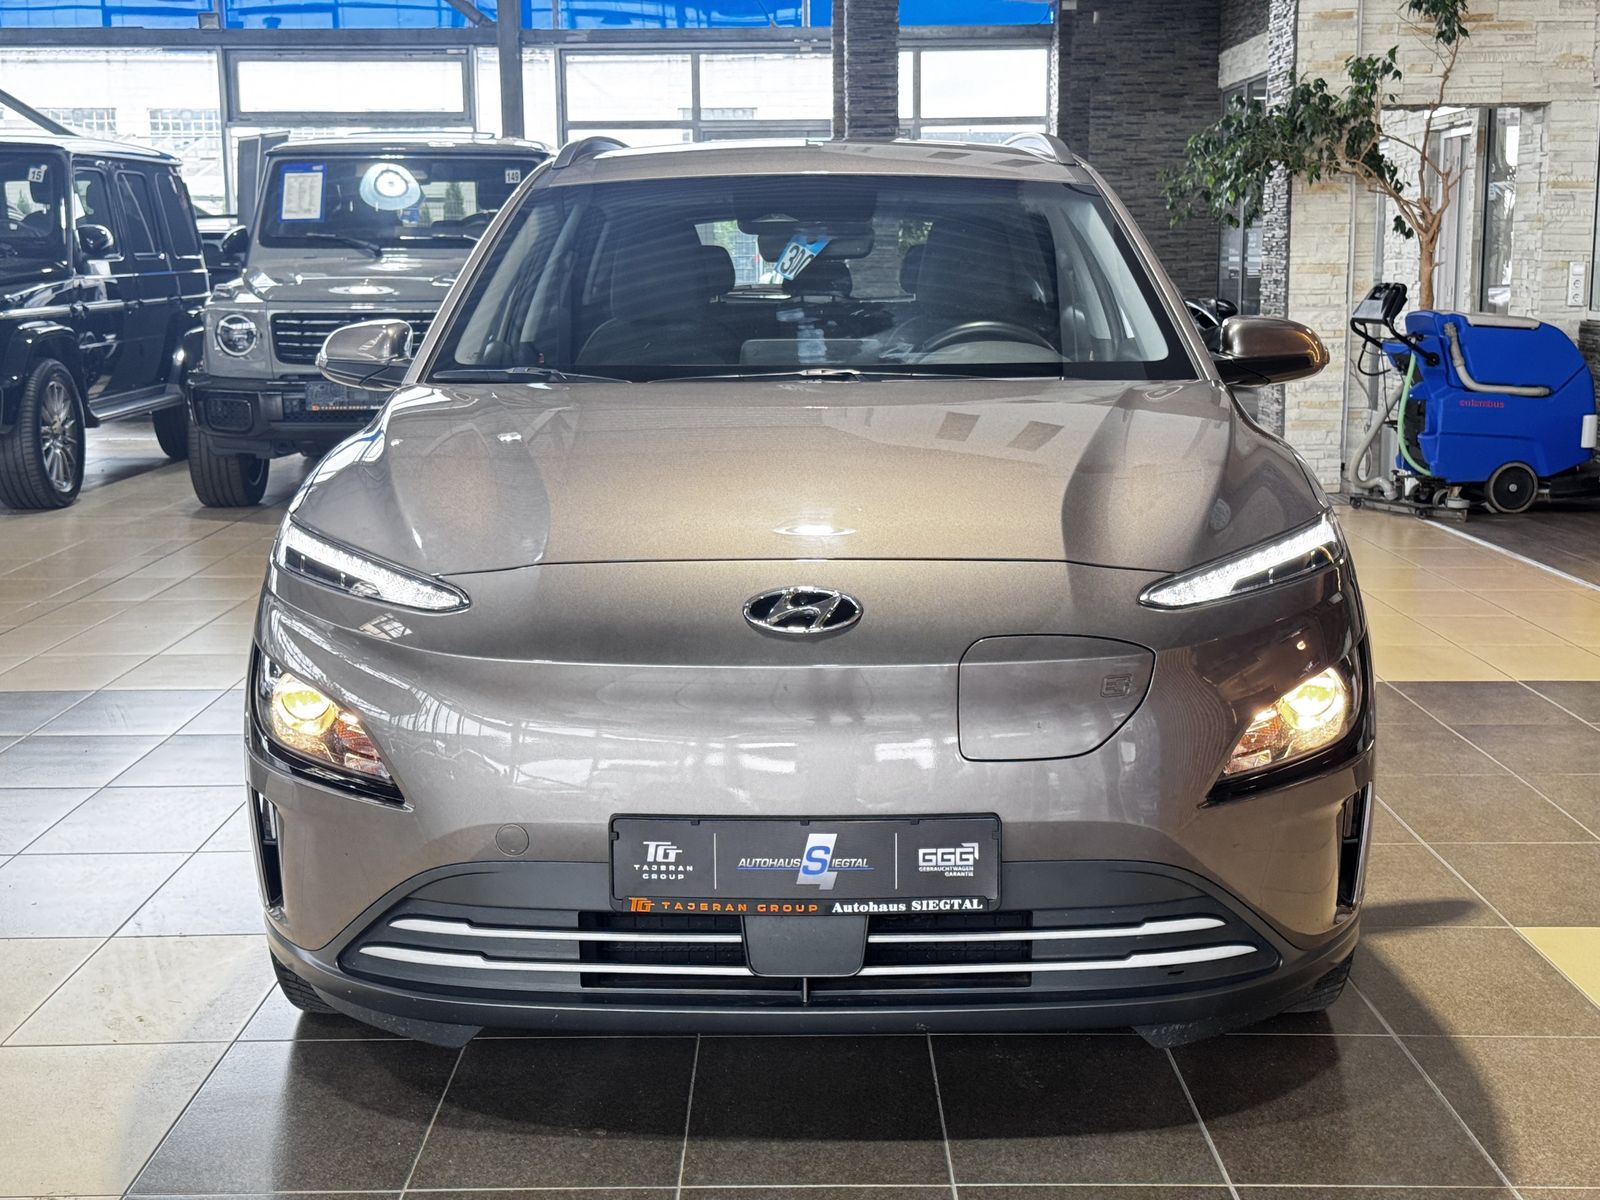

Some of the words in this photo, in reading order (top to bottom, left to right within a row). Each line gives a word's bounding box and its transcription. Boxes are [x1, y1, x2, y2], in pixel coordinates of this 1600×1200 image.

[31, 170, 42, 180] 15
[918, 848, 974, 866] GGG
[738, 858, 801, 868] AUTOHAUS
[662, 901, 747, 912] TAJERAN
[757, 904, 818, 912] GROUP
[832, 902, 906, 913] Autohaus
[911, 899, 983, 911] SIEGTAL
